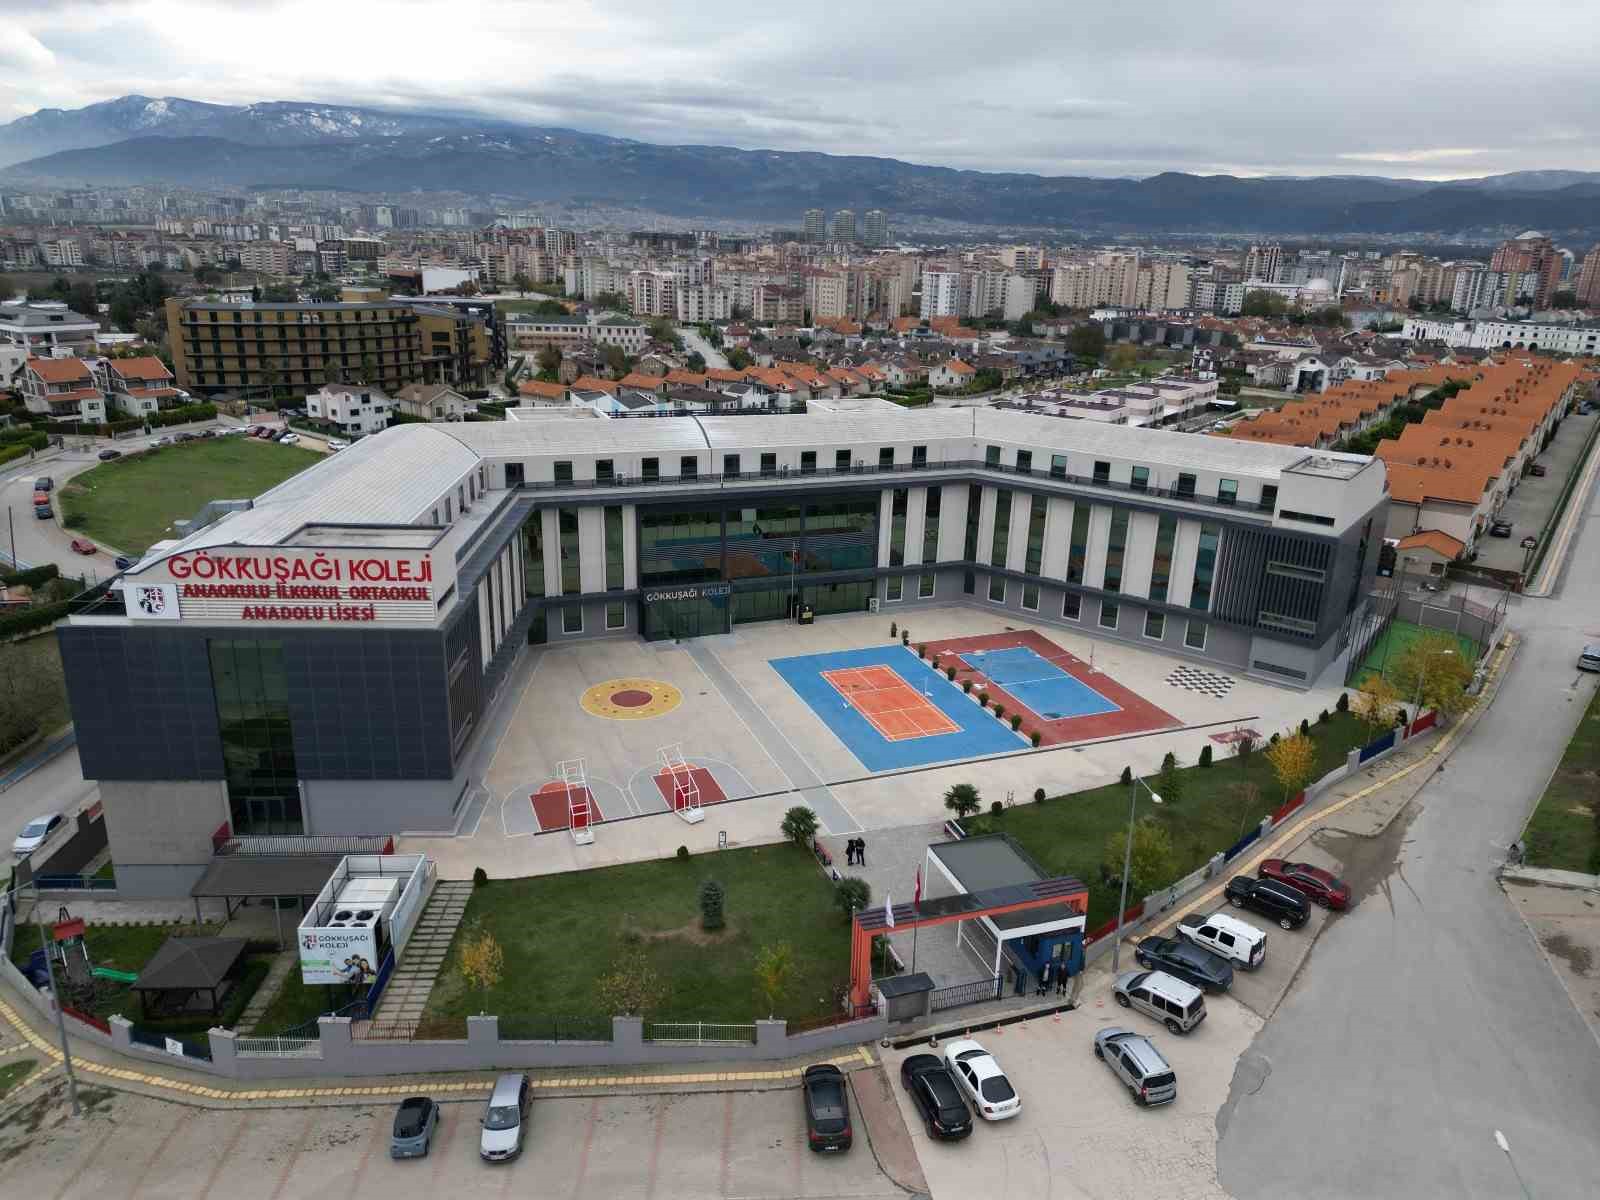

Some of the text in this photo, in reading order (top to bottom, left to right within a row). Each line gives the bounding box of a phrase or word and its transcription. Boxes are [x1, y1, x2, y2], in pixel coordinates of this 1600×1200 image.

[168, 551, 432, 584] GÖKKUŞAĞI KOLEJİ
[242, 602, 375, 621] ANADOLU LİSESİ
